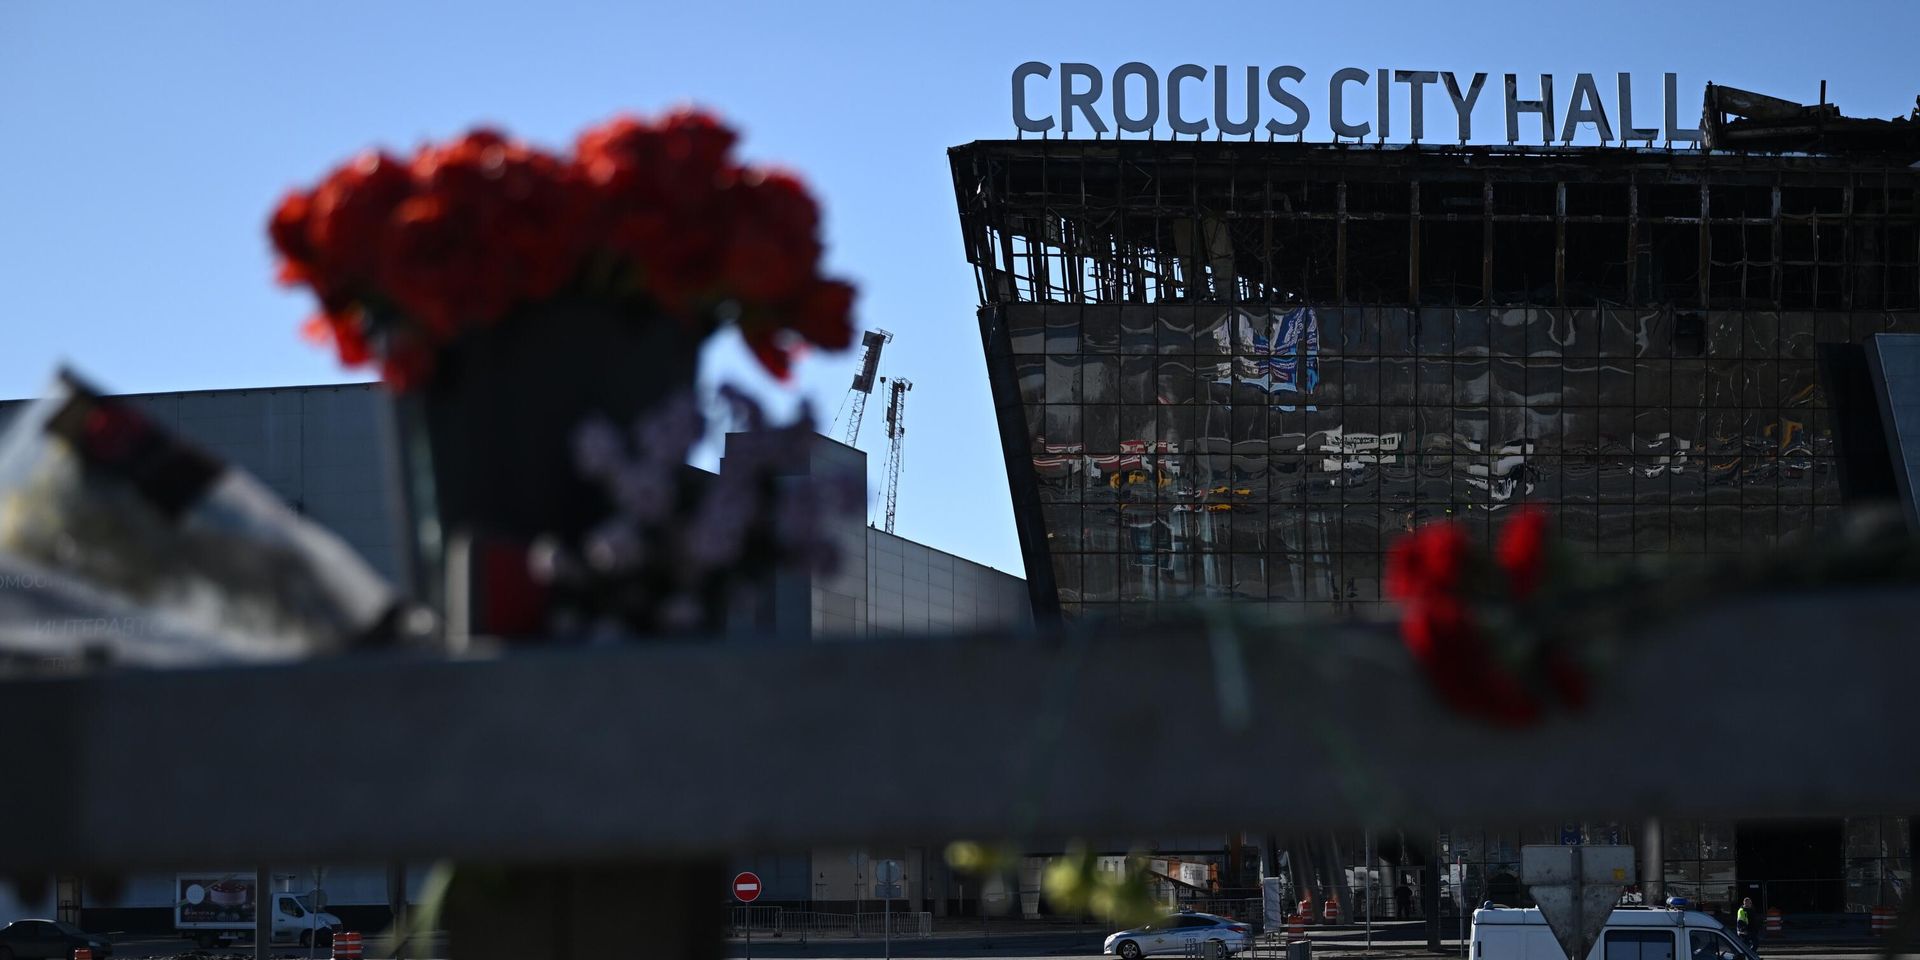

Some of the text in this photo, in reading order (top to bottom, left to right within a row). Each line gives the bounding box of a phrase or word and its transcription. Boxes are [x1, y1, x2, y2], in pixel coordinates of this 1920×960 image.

[1011, 61, 1701, 142] CROCUS CITY HALL
